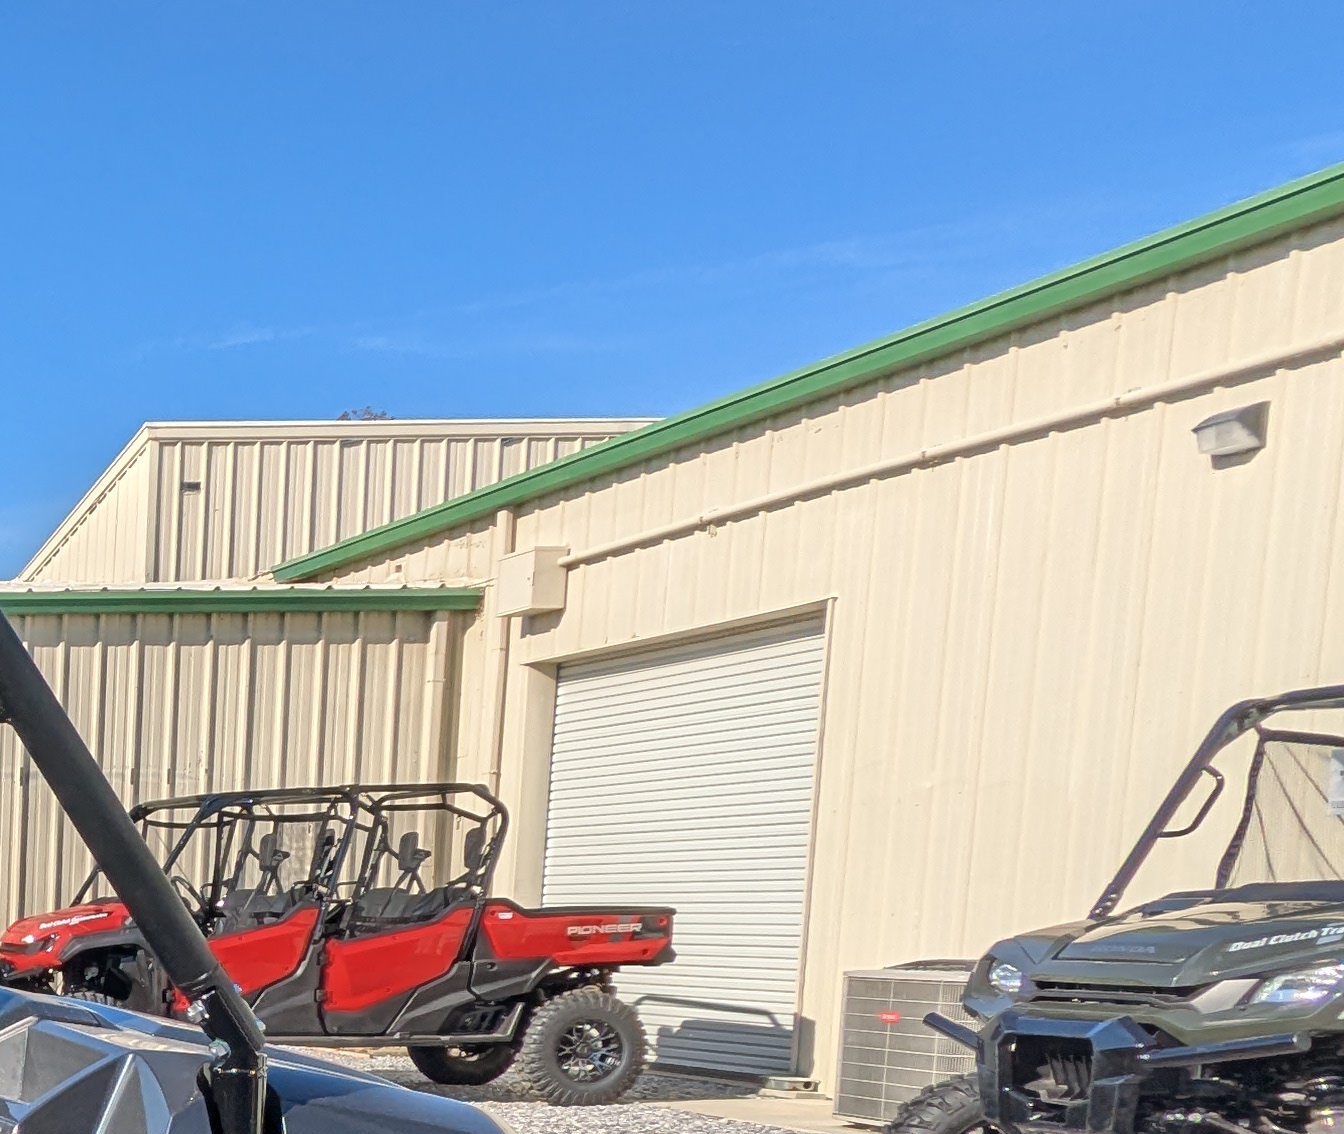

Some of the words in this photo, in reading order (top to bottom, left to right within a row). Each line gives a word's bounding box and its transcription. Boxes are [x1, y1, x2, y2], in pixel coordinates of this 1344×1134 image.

[567, 923, 643, 936] PIONEER
[1228, 938, 1268, 952] Dual
[1269, 929, 1319, 946] Clutch
